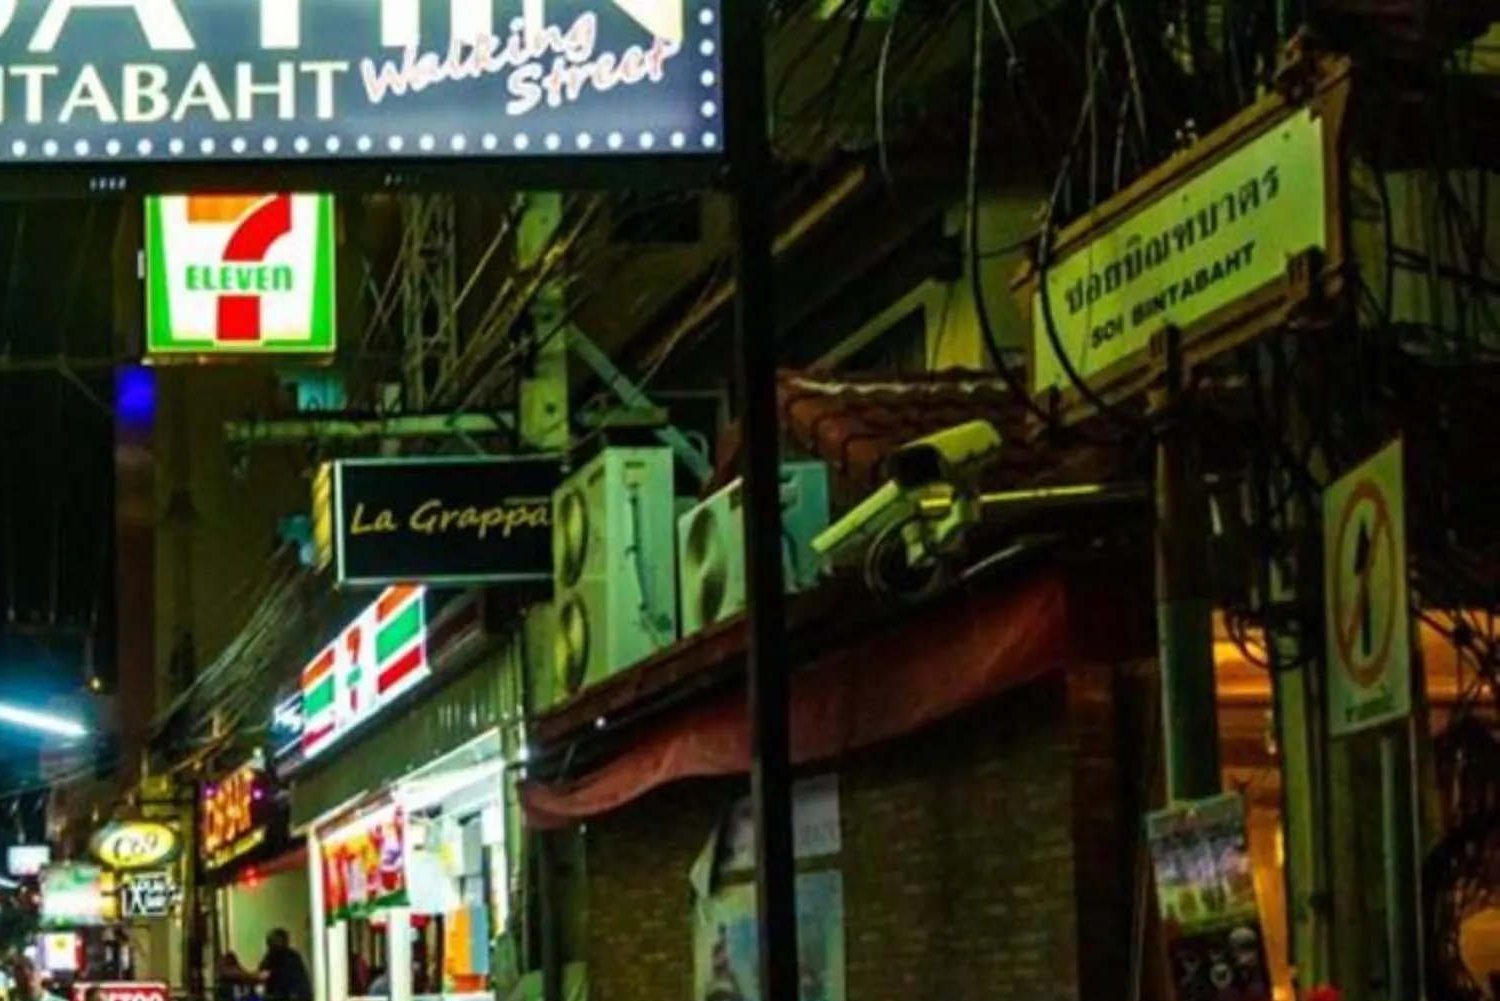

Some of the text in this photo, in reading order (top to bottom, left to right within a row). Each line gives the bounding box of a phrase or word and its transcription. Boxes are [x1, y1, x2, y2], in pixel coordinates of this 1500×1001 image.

[360, 11, 598, 104] Walking
[505, 34, 683, 117] Street
[186, 190, 292, 341] 7
[1091, 240, 1256, 350] SOI BINTABAHT
[350, 499, 551, 540] La Grappa
